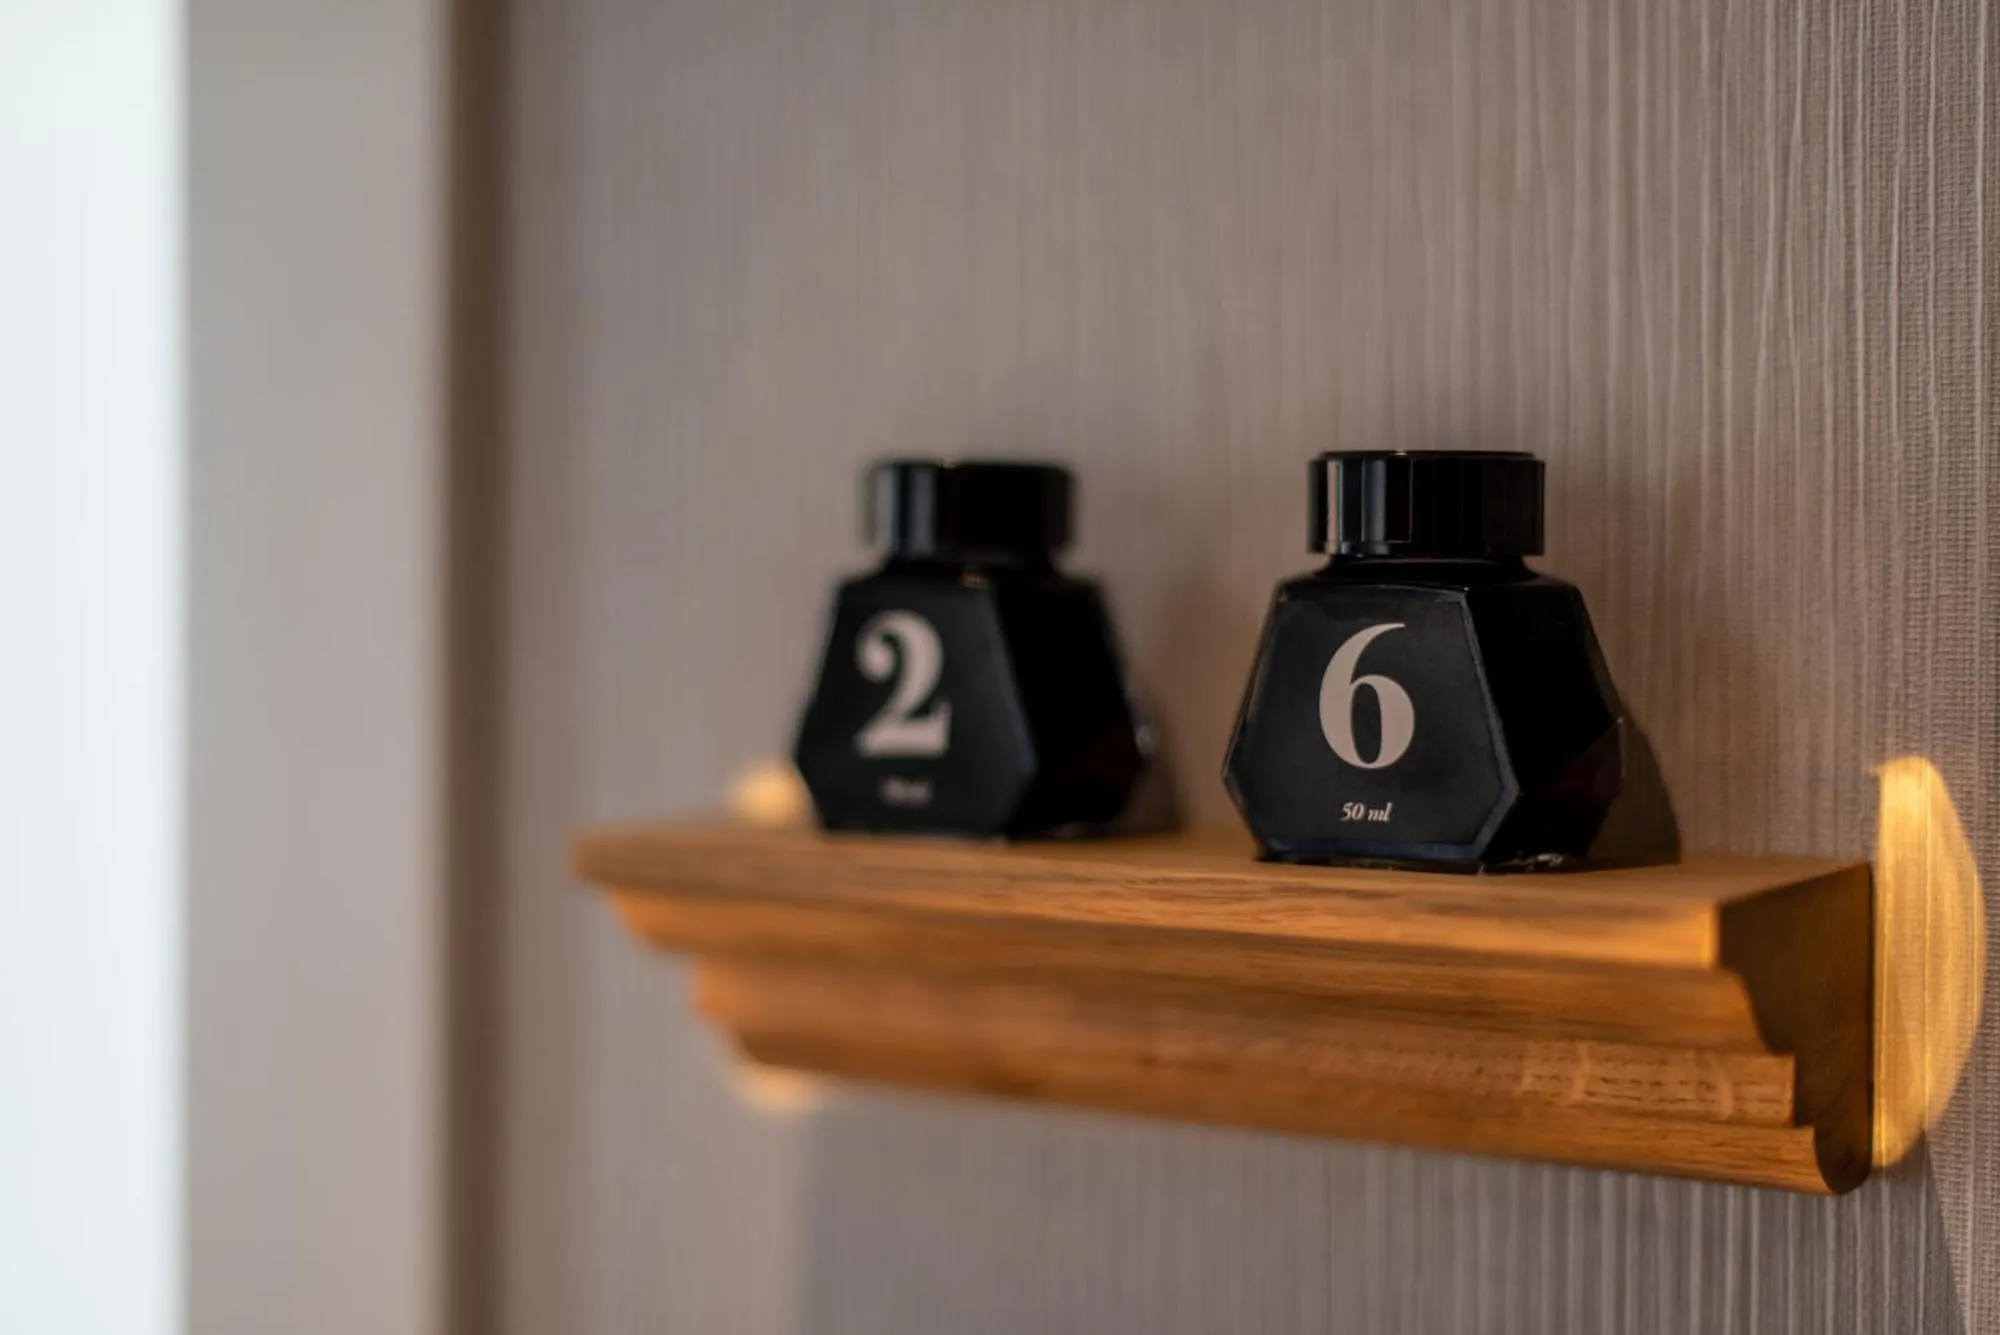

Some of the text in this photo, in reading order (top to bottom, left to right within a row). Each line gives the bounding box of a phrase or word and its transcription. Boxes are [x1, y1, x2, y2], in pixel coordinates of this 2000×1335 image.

[857, 611, 950, 757] 2
[1319, 622, 1415, 769] 6
[1341, 802, 1393, 822] 50 ml
